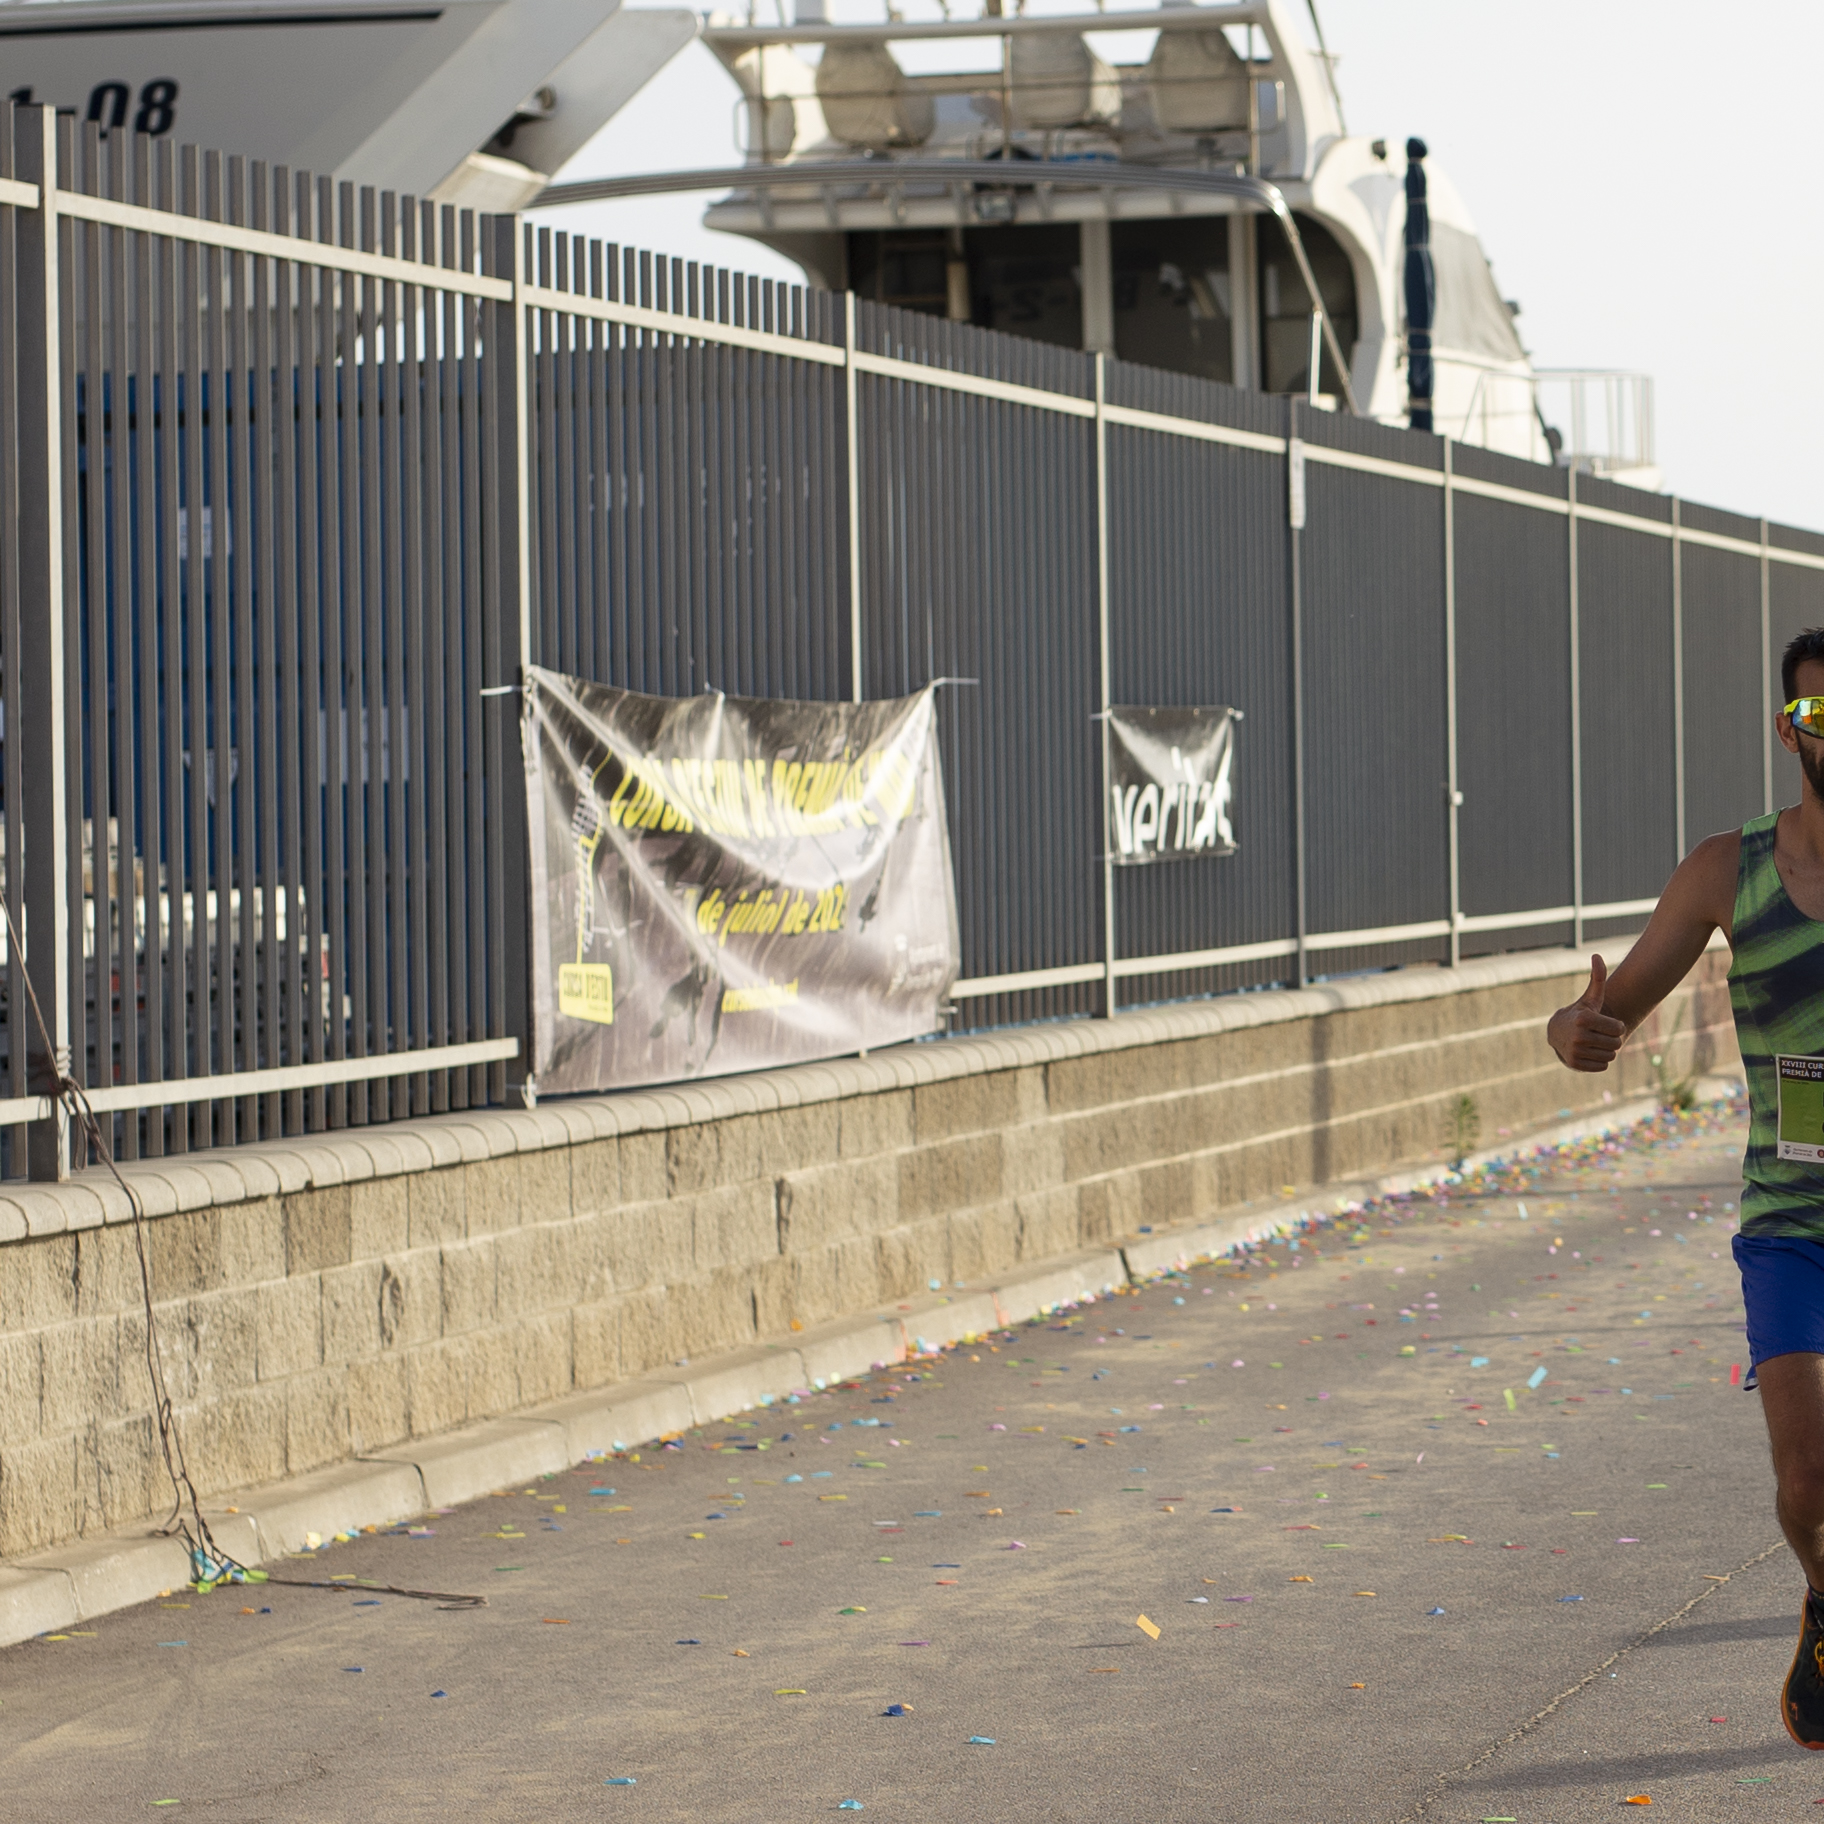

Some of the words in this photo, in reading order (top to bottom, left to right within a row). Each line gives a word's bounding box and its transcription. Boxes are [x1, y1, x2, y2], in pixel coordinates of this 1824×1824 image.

[697, 888, 725, 935] de
[718, 887, 788, 948] juliol
[781, 888, 810, 935] de
[1781, 1060, 1807, 1069] XXVIII
